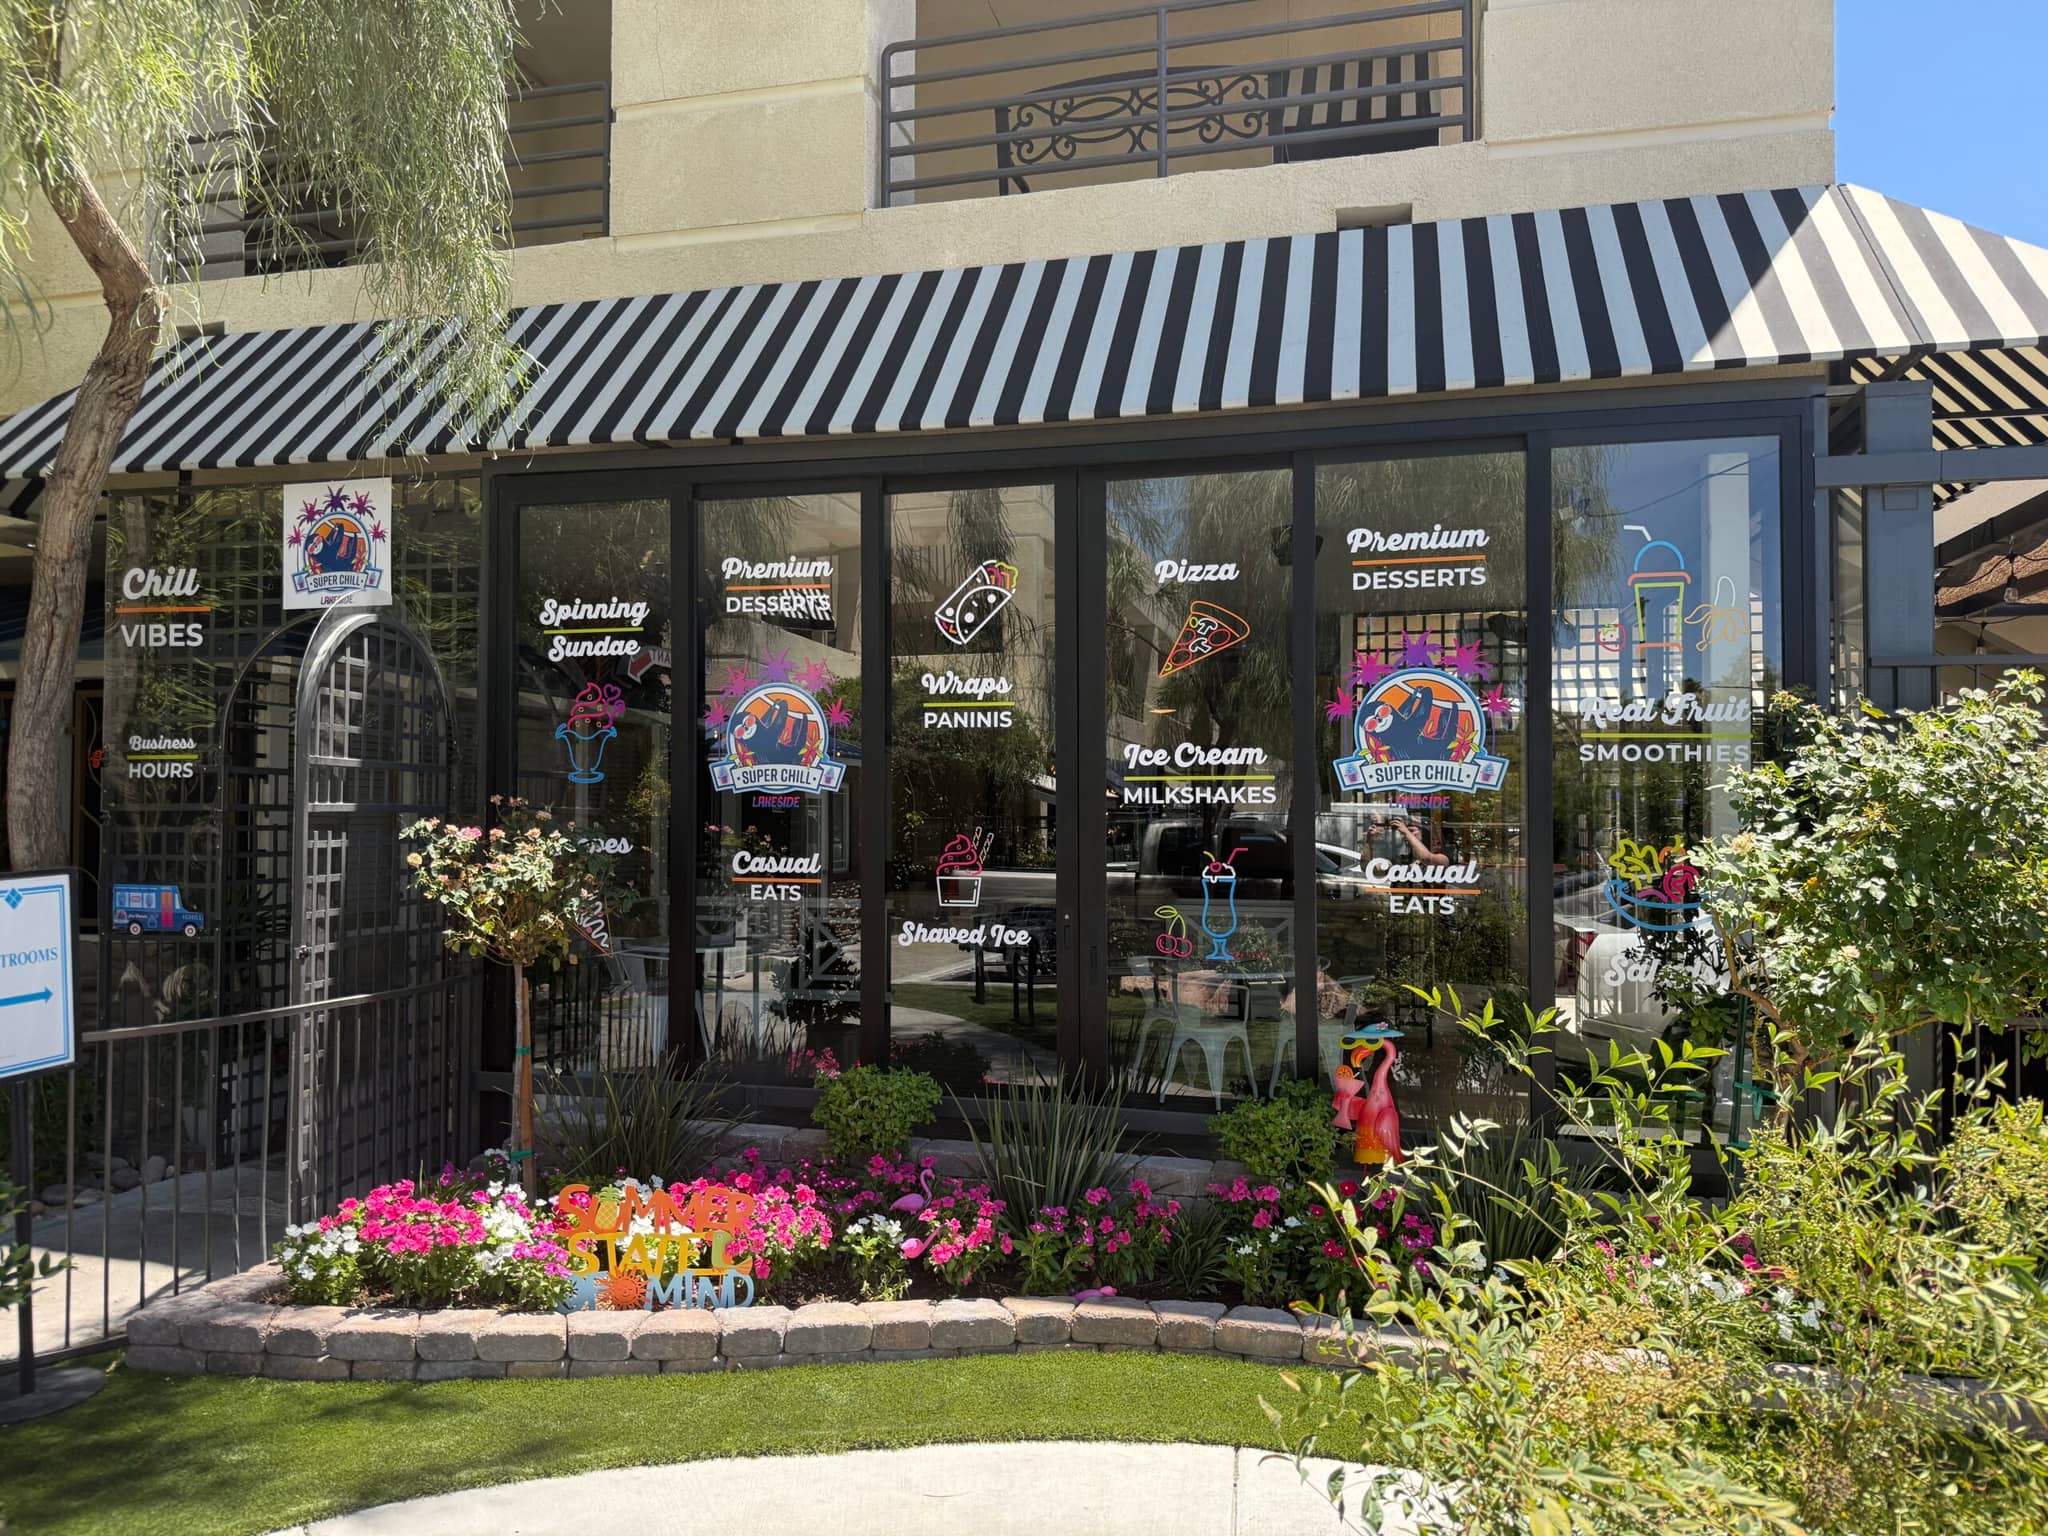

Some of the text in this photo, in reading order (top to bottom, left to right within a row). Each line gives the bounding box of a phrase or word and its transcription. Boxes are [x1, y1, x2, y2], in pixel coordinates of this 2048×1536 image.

[1346, 523, 1490, 554] Premium
[721, 555, 834, 581] Premium
[1154, 559, 1240, 584] Pizza
[1352, 566, 1487, 591] DESSERTS
[122, 566, 201, 600] Chill
[313, 573, 361, 589] SUPER CHILL
[539, 596, 650, 627] Spinning
[726, 595, 831, 613] DESSERTS
[120, 622, 204, 648] VIBES
[549, 635, 641, 662] Sundae
[921, 670, 1013, 700] Wraps
[923, 711, 1013, 728] PANINIS
[1579, 692, 1752, 730] Real Fruit
[128, 735, 197, 752] Business
[1123, 742, 1268, 768] Ice Cream
[1579, 743, 1750, 764] SMOOTHIES
[128, 762, 194, 780] HOURS
[741, 768, 811, 785] SUPER CHILL
[1375, 764, 1464, 783] SUPER CHILL
[752, 795, 800, 808] LAKESIDE
[1123, 786, 1277, 804] MILKSHAKES
[732, 850, 821, 875] Casual
[1366, 857, 1480, 886] Casual
[750, 884, 801, 901] EATS
[1389, 896, 1456, 915] EATS
[898, 920, 1031, 946] Shaved Ice
[0, 947, 58, 969] TROOMS
[644, 1267, 755, 1310] MIND
